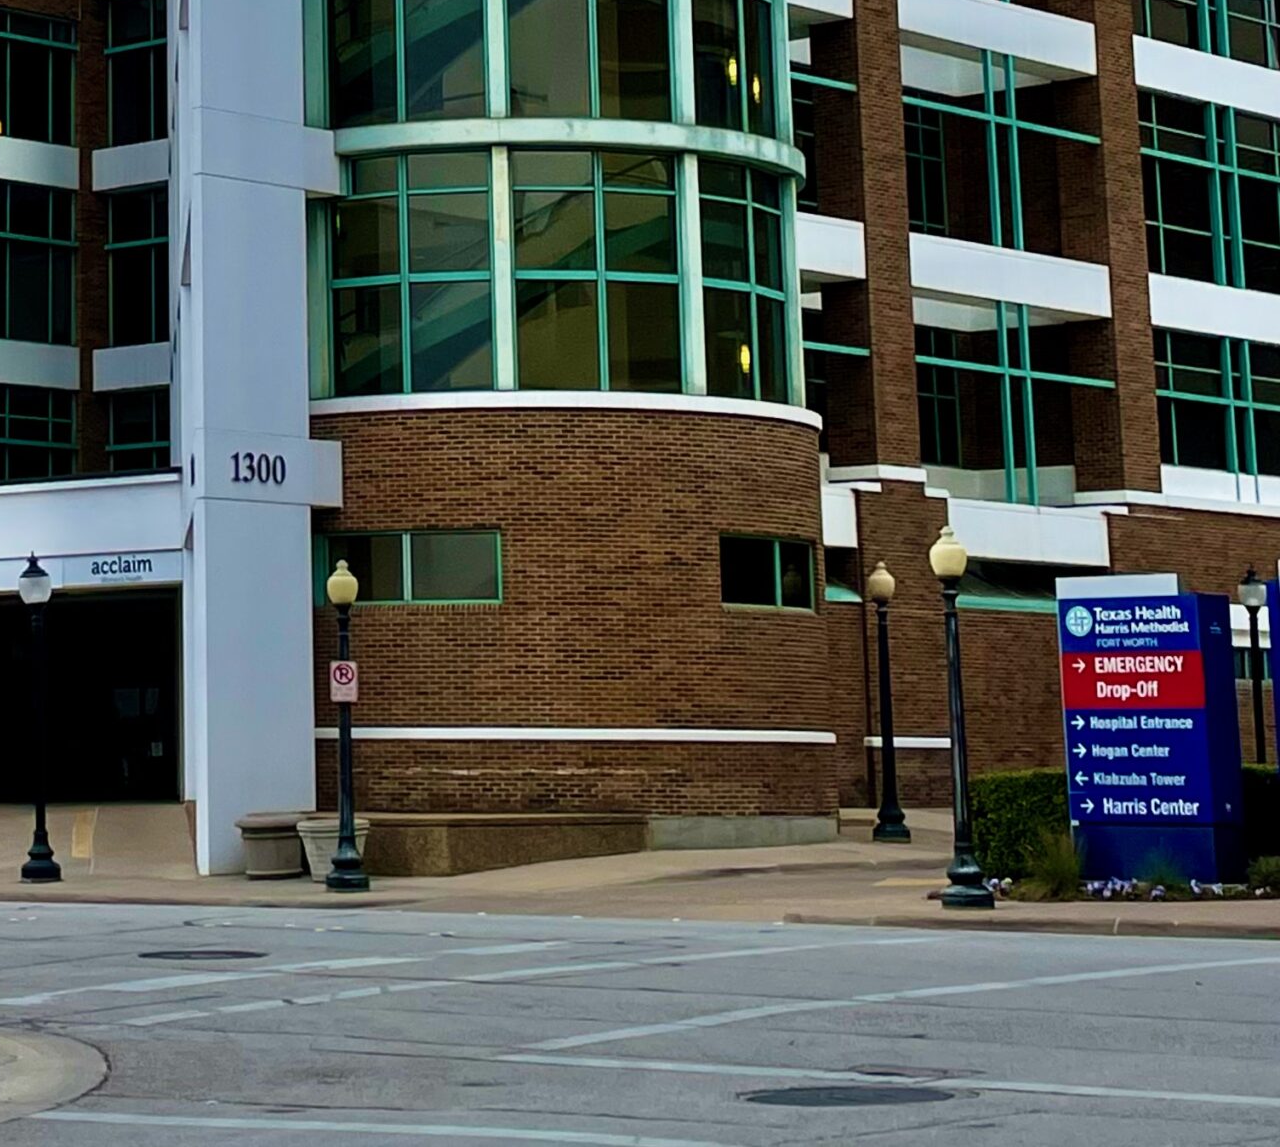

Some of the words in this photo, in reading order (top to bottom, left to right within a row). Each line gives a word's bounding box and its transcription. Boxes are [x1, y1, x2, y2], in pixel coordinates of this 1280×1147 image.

[230, 451, 286, 485] 1300
[91, 555, 154, 576] acclaim
[1093, 607, 1132, 621] Texas
[1135, 604, 1181, 620] Health
[1095, 622, 1129, 634] Harris
[1130, 621, 1189, 633] Methodist
[1096, 637, 1120, 648] FORT
[1122, 637, 1158, 648] WORTH
[1095, 655, 1183, 673] EMERGENCY
[1096, 680, 1158, 702] Drop-Off
[1090, 716, 1137, 732] Hospital
[1140, 715, 1193, 729] Entrance
[1092, 744, 1128, 760] Hogan
[1131, 744, 1170, 757] Center
[1093, 772, 1147, 786] Klabzuba
[1150, 772, 1186, 786] Tower
[1103, 797, 1147, 815] Harris
[1150, 798, 1200, 816] Center
